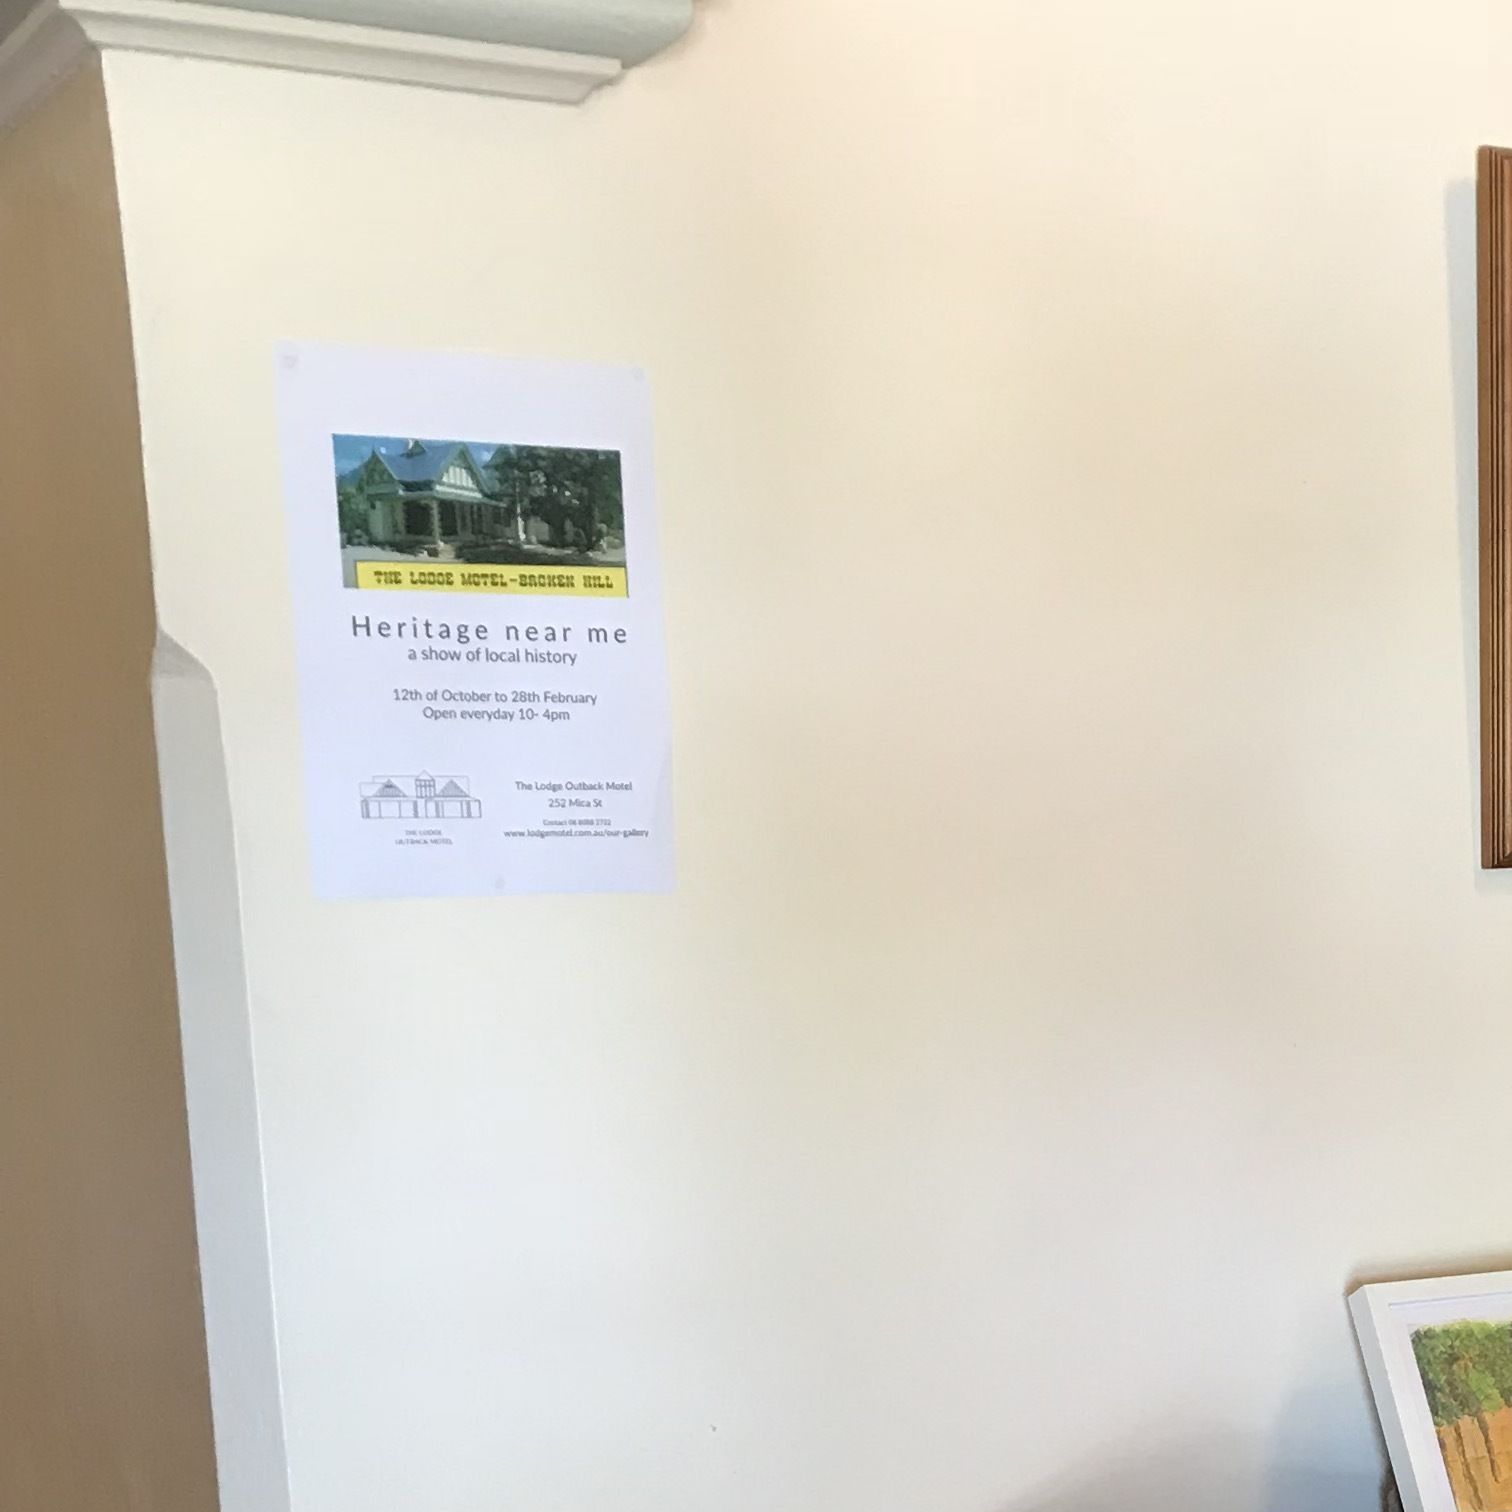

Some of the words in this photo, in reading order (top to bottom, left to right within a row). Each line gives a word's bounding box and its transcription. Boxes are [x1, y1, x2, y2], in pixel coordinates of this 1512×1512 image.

[374, 570, 402, 585] THE
[410, 571, 454, 586] LODGE
[583, 574, 614, 589] HILL
[352, 615, 489, 645] Heritage
[506, 623, 571, 642] near
[588, 626, 627, 644] me
[408, 648, 417, 660] a
[421, 646, 462, 661] show
[466, 647, 482, 662] of
[486, 648, 520, 663] local
[525, 648, 577, 666] history
[393, 688, 422, 702] 12th
[426, 688, 438, 702] of
[442, 689, 492, 703] October
[494, 690, 508, 703] to
[511, 690, 540, 704] 28th
[543, 690, 598, 705] February
[422, 706, 457, 721] Open
[460, 707, 515, 722] everyday
[542, 709, 570, 722] 4pm
[515, 781, 534, 791] The
[535, 781, 560, 792] Lodge
[565, 781, 604, 791] Outback
[606, 781, 633, 791] Motel
[548, 798, 567, 808] 252
